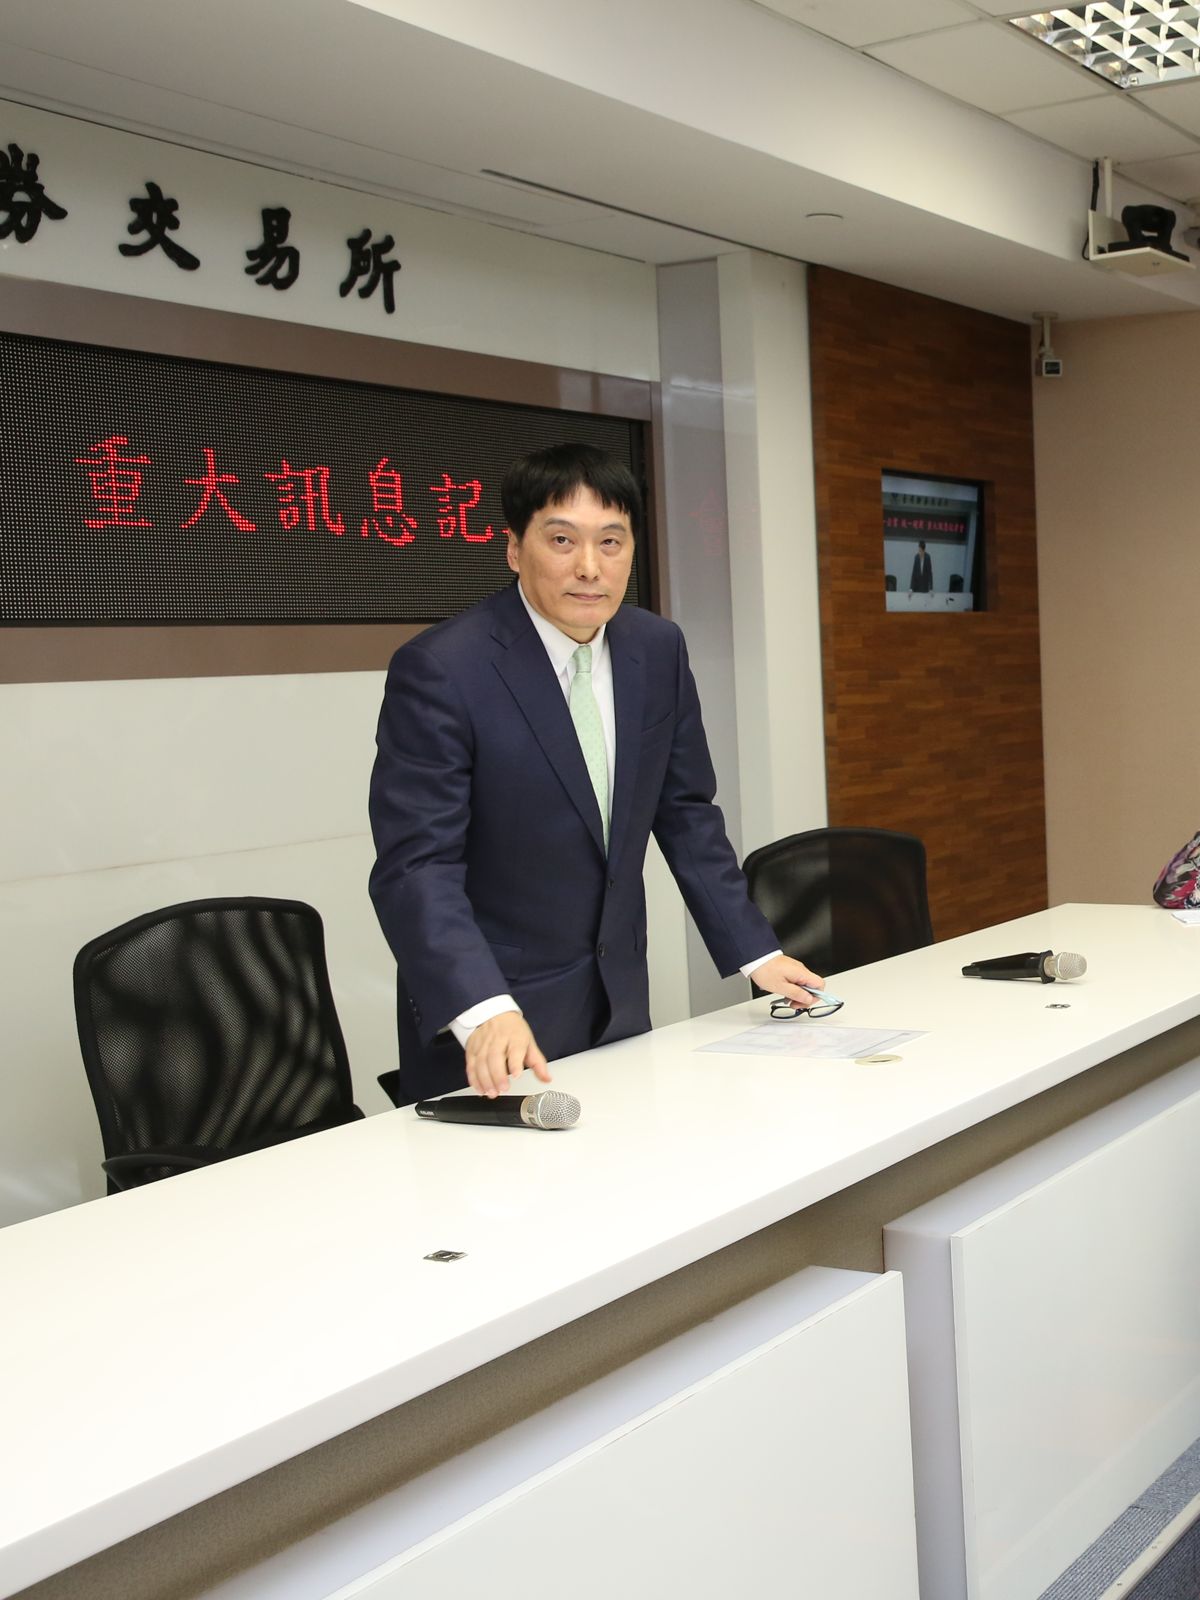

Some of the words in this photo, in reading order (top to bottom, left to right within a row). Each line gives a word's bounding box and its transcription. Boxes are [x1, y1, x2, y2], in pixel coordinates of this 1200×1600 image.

[75, 435, 510, 546] 重大訊息記
